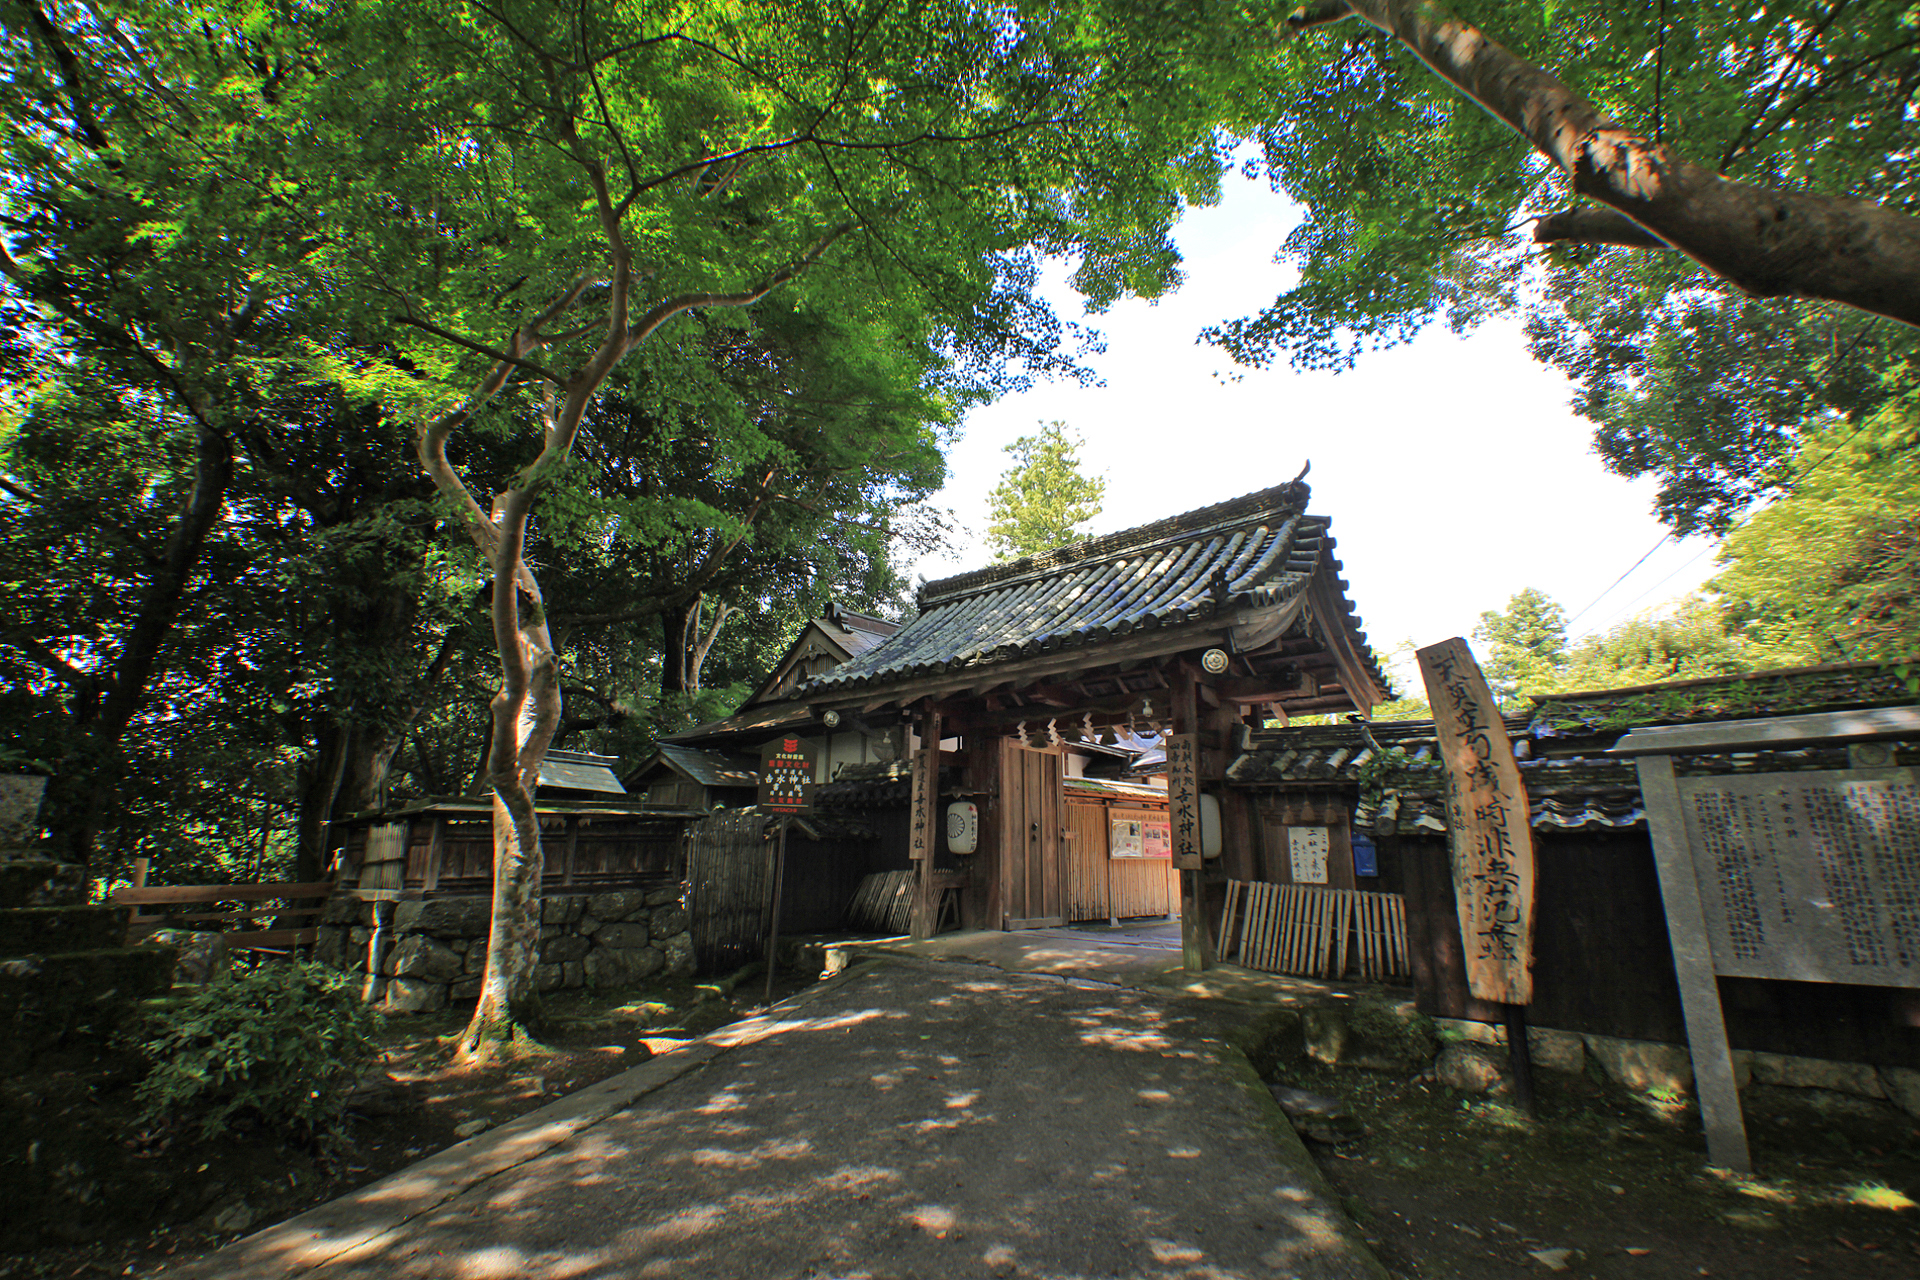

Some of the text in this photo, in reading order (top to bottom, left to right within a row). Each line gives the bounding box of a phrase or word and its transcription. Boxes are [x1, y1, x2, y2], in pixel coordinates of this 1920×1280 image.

[768, 760, 810, 769] 重要文化財
[764, 773, 811, 785] 吉水神社
[1174, 787, 1198, 855] 吉水神社
